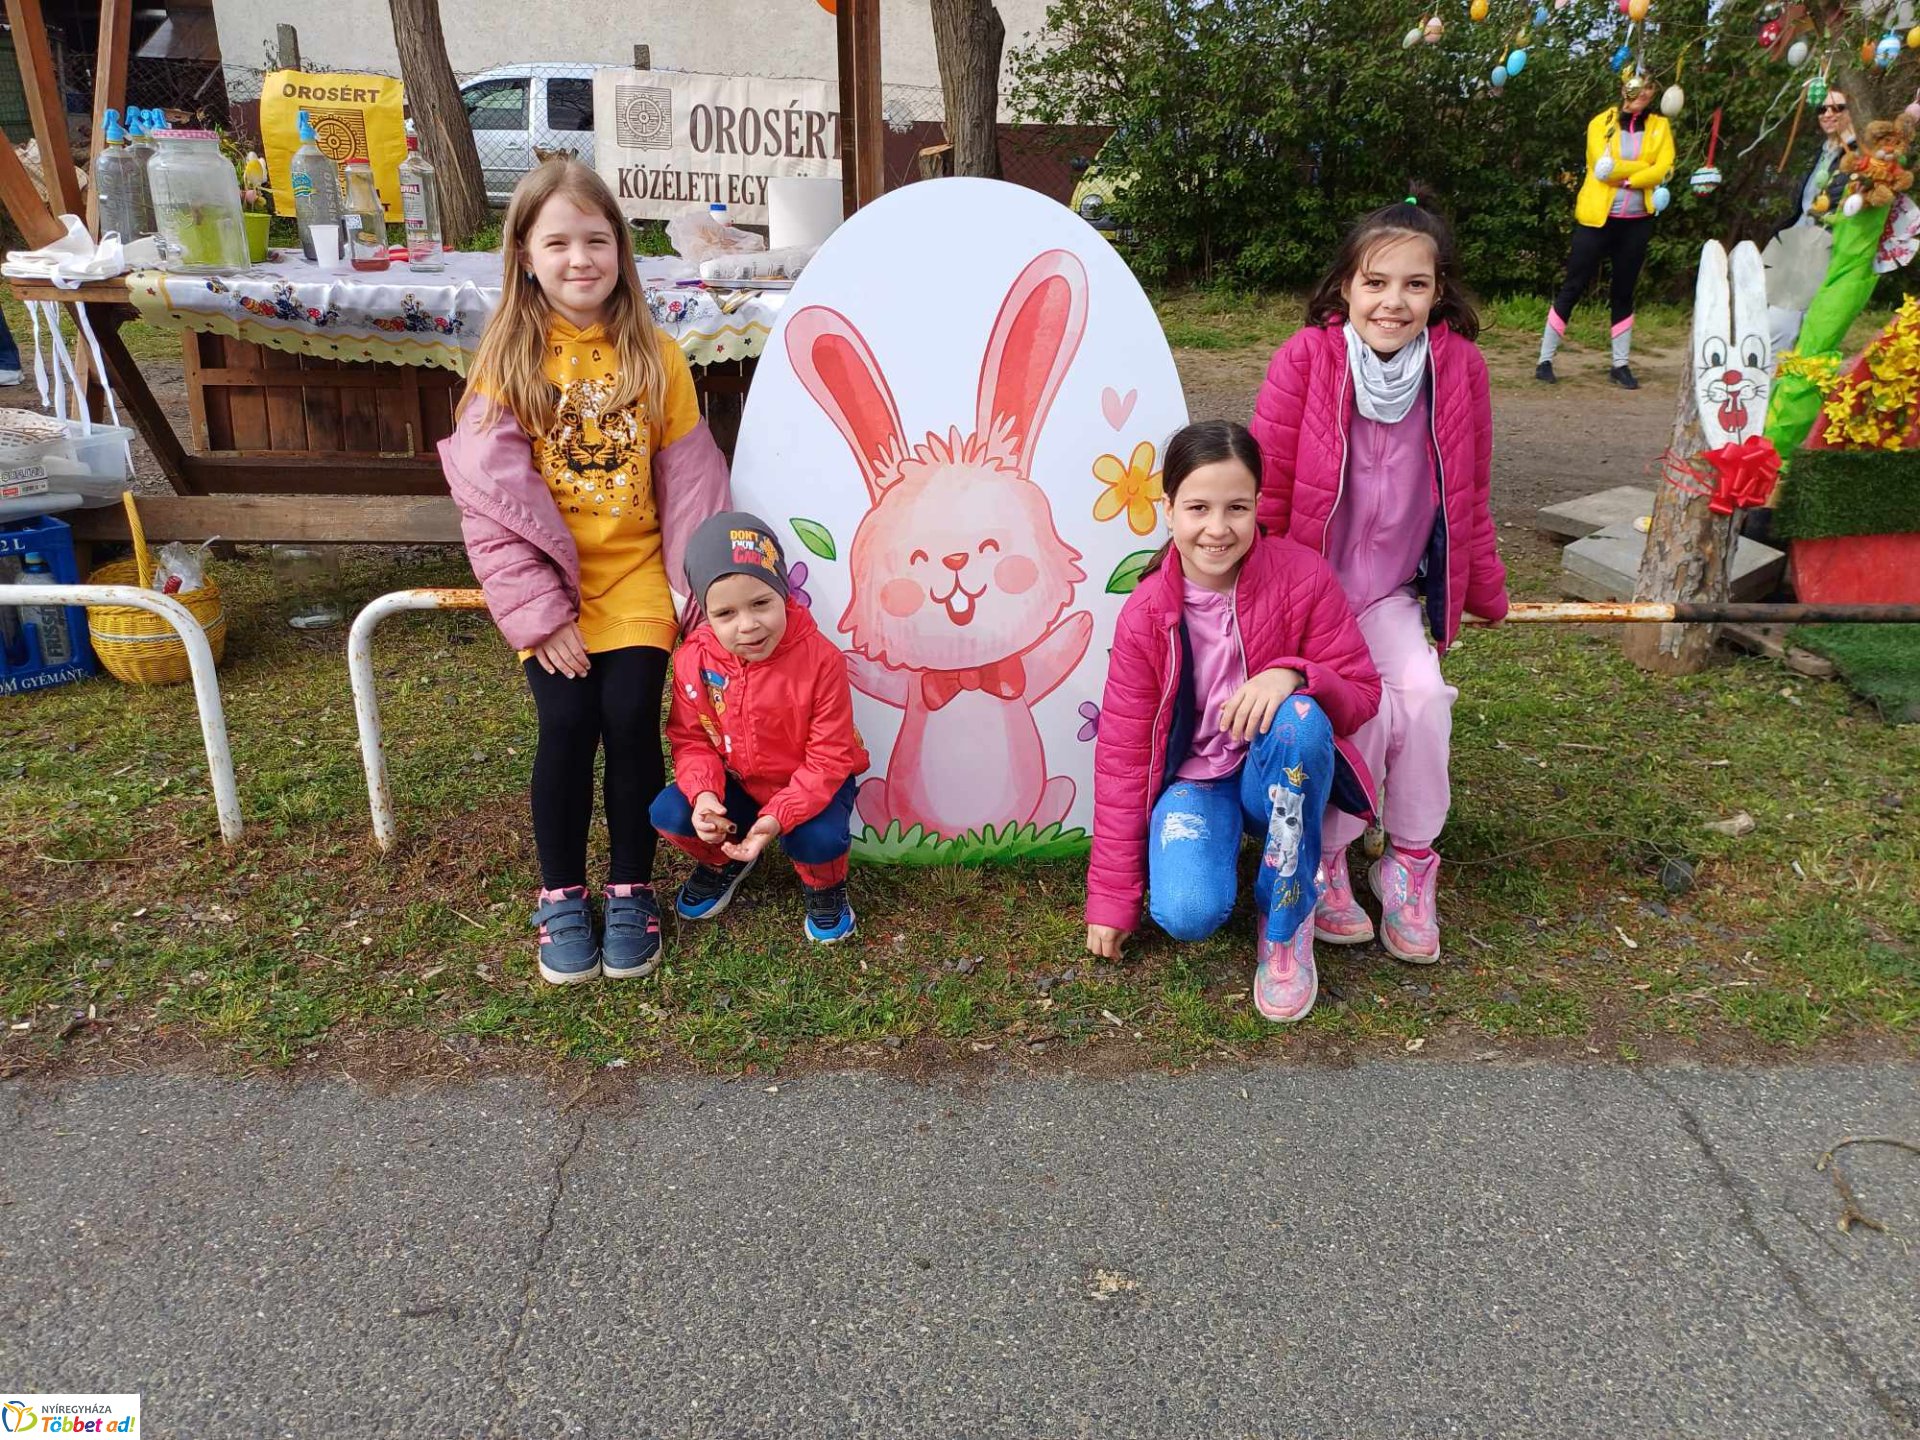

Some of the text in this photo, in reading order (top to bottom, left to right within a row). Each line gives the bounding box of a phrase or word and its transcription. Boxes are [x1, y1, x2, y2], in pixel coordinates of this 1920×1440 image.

[282, 83, 380, 103] OROSÉRT
[689, 99, 843, 160] OROSÉRT
[618, 163, 721, 203] KÖZÉLETI
[13, 538, 26, 550] L
[21, 667, 84, 689] GYÉMÁNT
